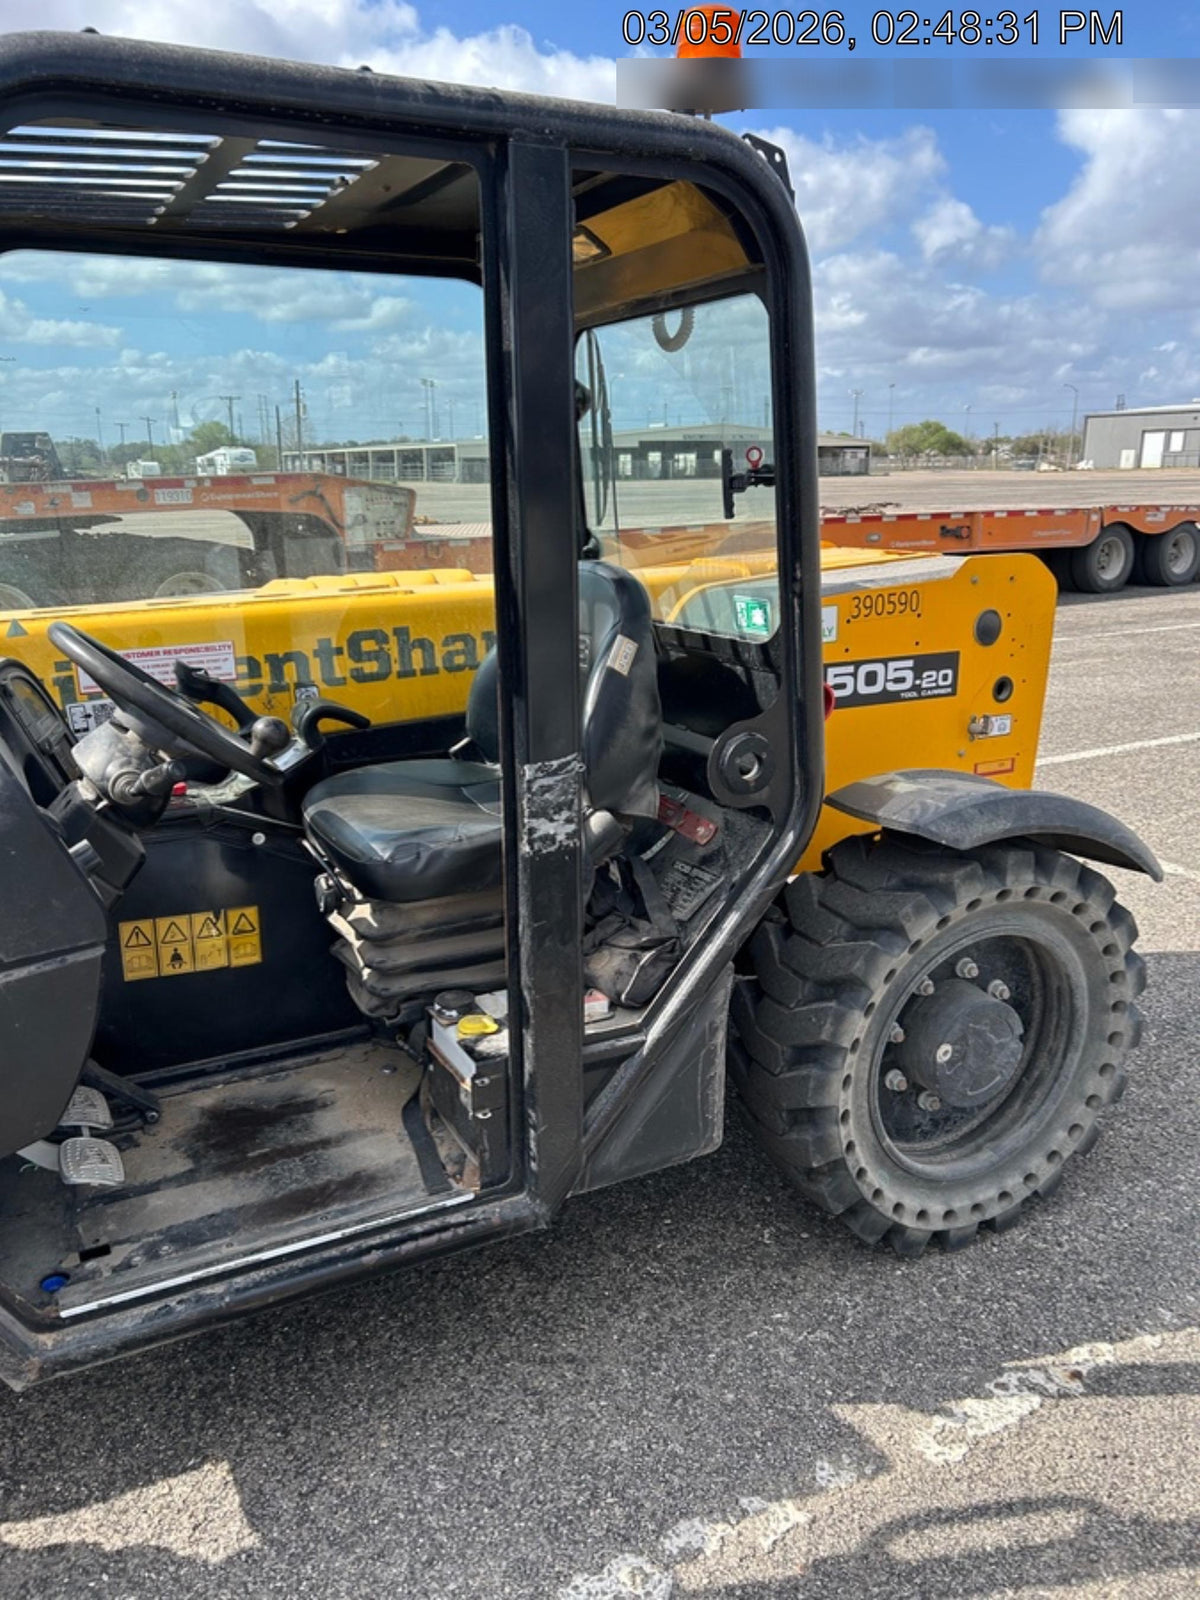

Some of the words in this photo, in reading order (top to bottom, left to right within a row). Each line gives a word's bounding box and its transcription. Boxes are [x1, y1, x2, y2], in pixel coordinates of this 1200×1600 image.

[850, 590, 920, 619] 390590
[821, 625, 835, 638] LY
[121, 650, 161, 661] USTOMER
[162, 644, 232, 657] RESPONSIBILITY
[826, 659, 953, 698] 505-20
[900, 690, 920, 699] TOOL
[921, 687, 953, 697] CARRIER
